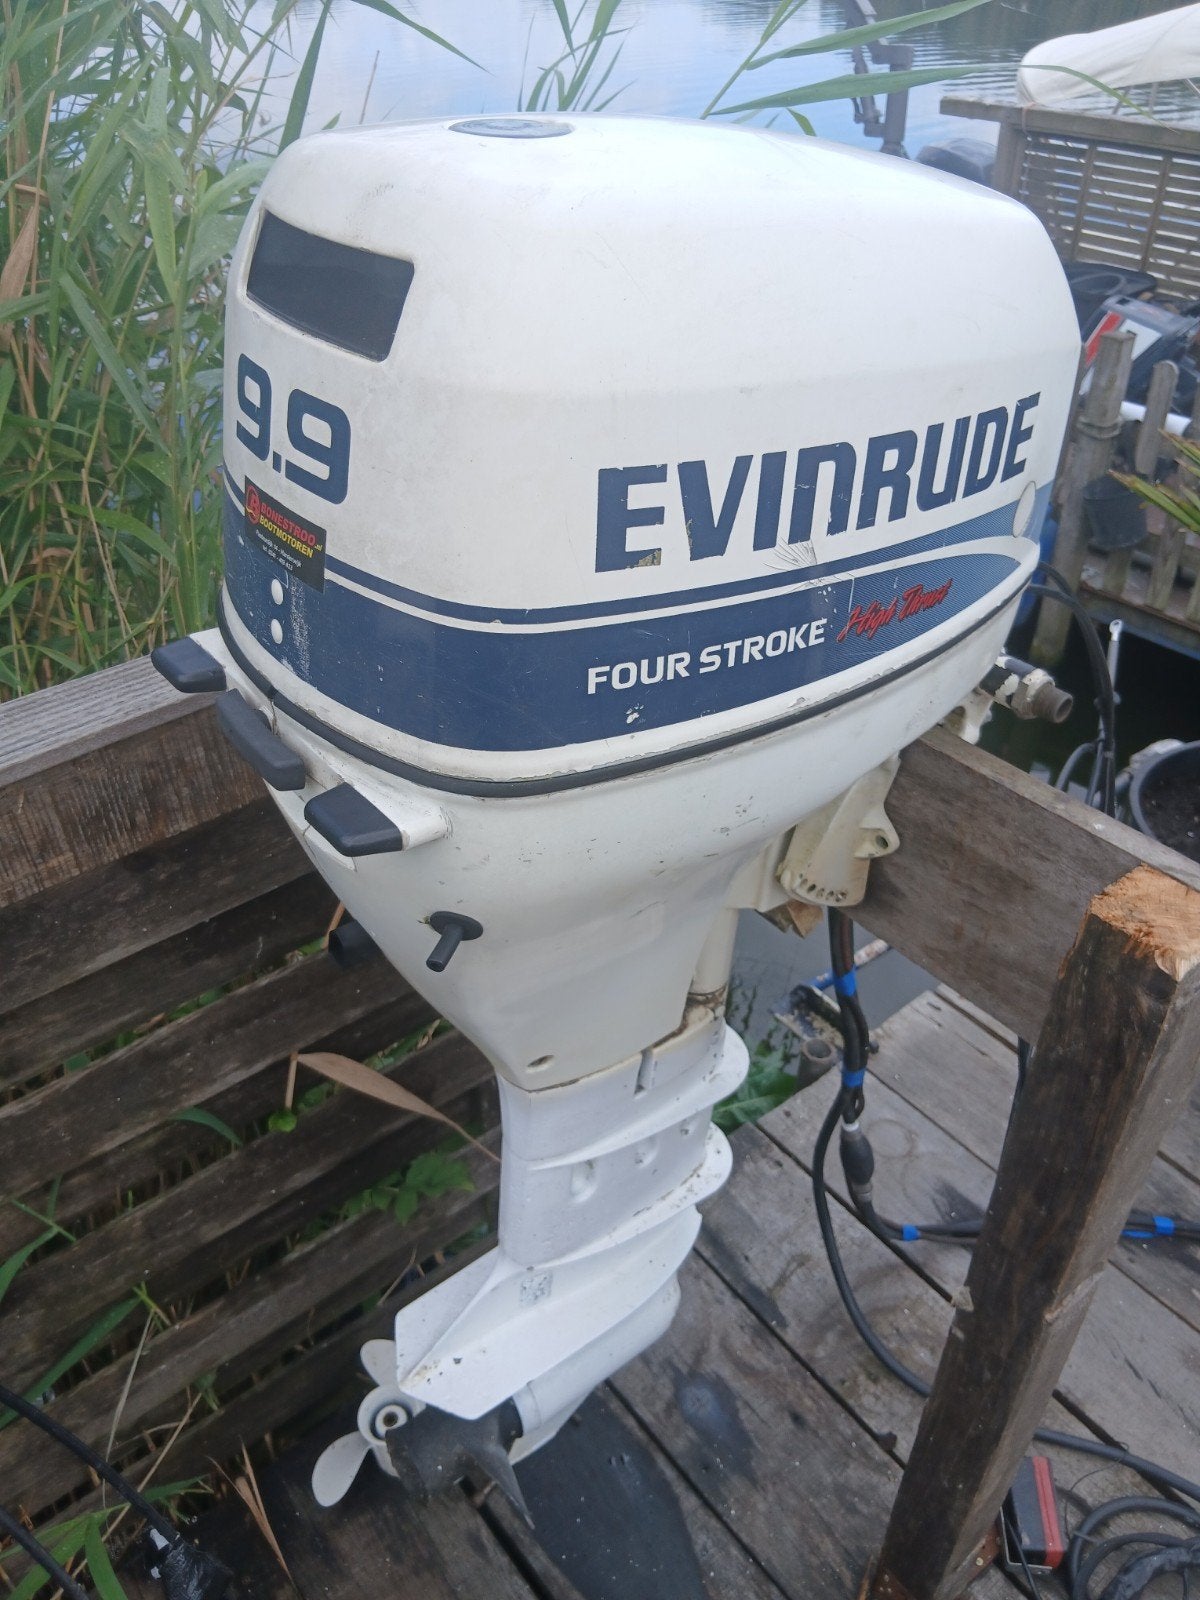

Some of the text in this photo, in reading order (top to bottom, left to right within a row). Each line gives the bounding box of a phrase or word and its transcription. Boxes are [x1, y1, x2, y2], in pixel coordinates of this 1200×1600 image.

[236, 353, 351, 504] 9.9
[595, 391, 1041, 573] EVINRUDE
[260, 515, 313, 558] BOOTMOTOREN
[261, 503, 316, 546] BONESTROO
[836, 578, 953, 643] High Thrust
[587, 618, 827, 694] FOUR STROKE
